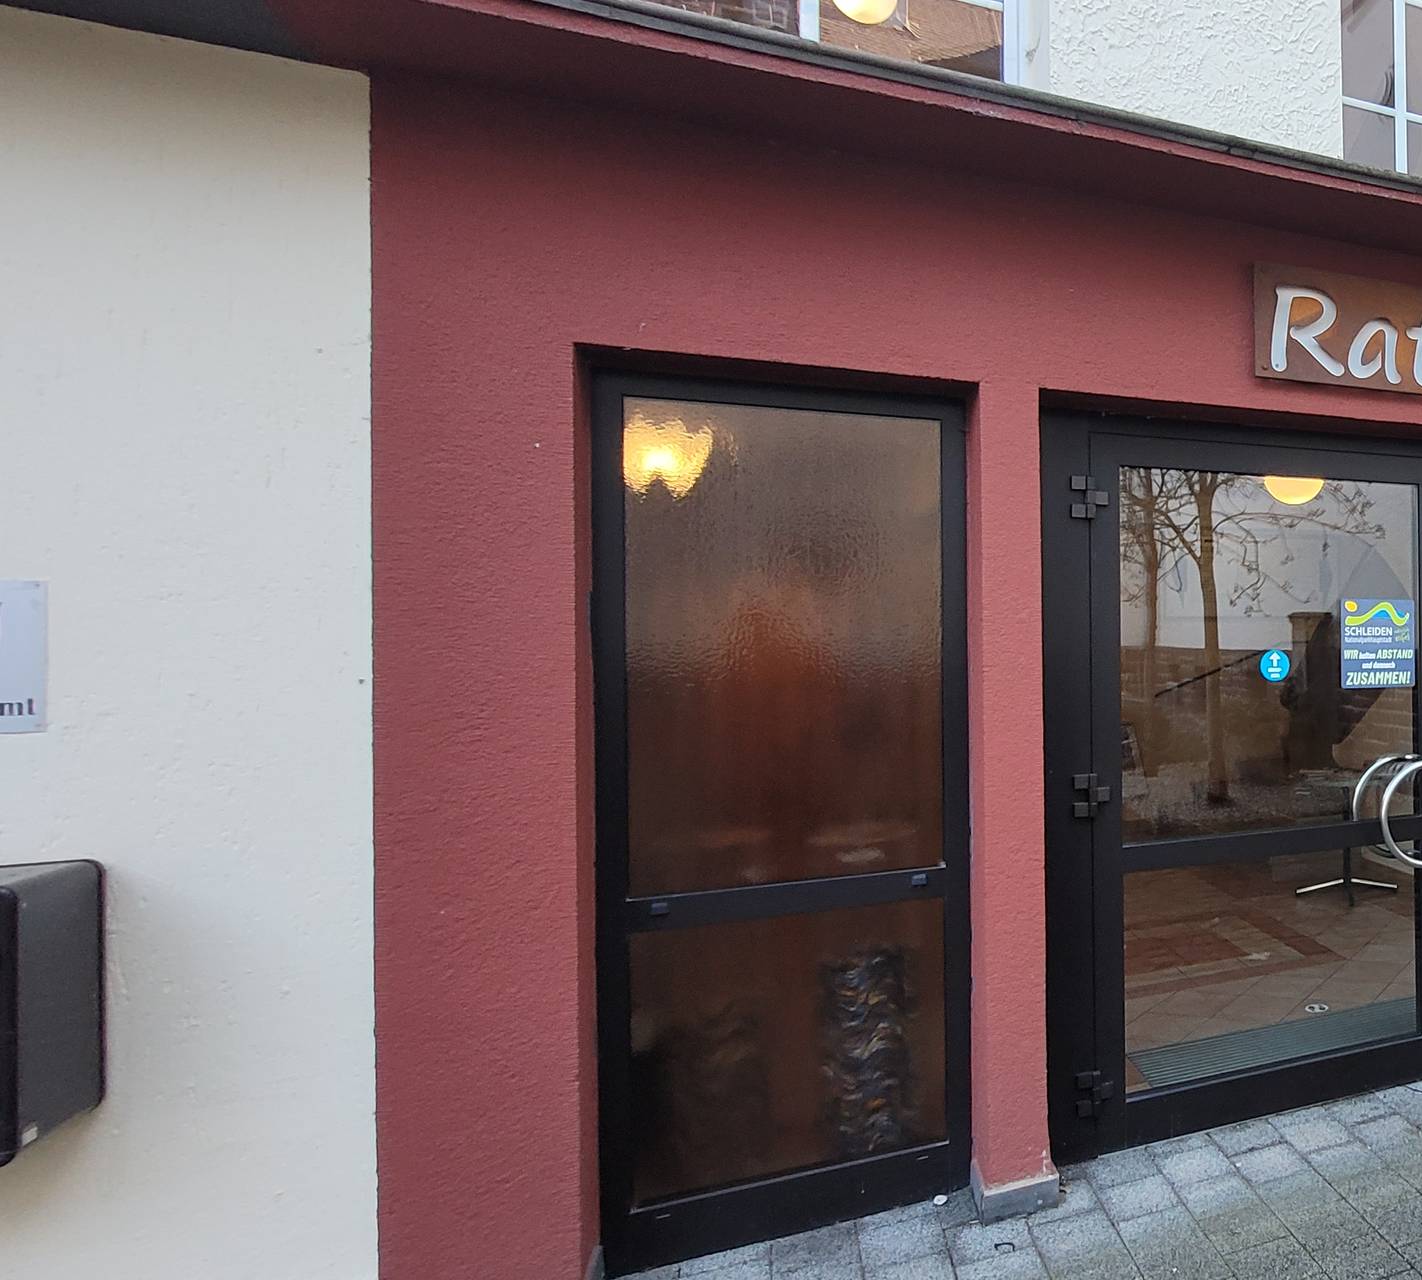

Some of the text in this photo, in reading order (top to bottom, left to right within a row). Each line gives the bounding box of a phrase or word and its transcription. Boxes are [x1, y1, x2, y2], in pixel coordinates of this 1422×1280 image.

[1344, 626, 1393, 636] SCHLEIDEN
[1343, 649, 1359, 660] WIR
[1376, 649, 1414, 660] ABSTAND
[1345, 671, 1411, 686] ZUSAMMEN!
